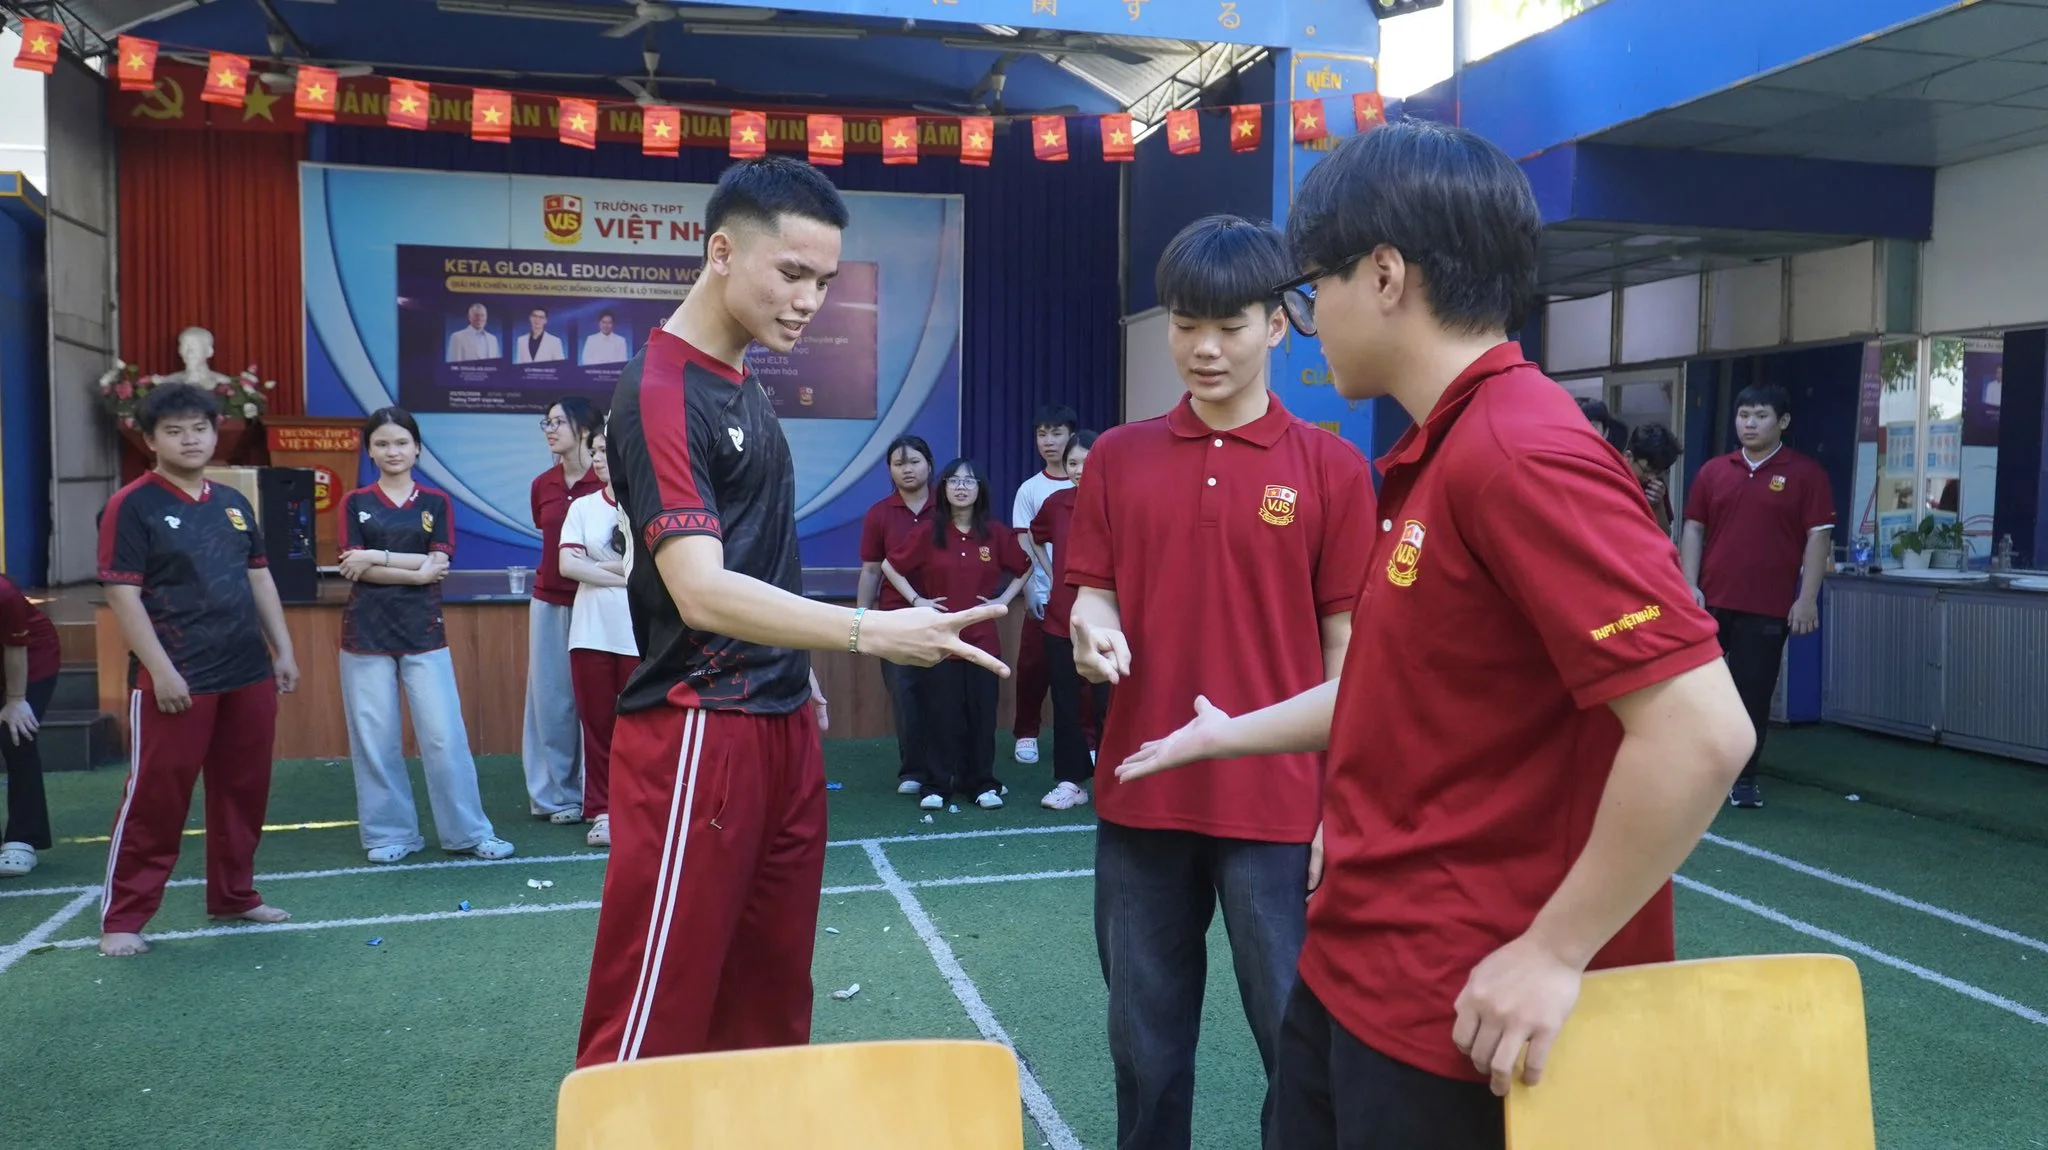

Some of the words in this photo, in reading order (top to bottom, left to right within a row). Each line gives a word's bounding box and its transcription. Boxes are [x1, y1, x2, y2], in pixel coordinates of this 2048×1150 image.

[512, 97, 540, 127] ẢN
[609, 110, 643, 133] NA
[680, 114, 731, 138] QUA
[766, 119, 806, 140] VIN
[917, 121, 959, 145] ĂM
[594, 200, 649, 213] TRƯỜNG
[652, 203, 684, 214] THPT
[548, 213, 579, 231] VJS
[594, 214, 663, 244] VIỆT
[671, 221, 704, 242] NH
[444, 258, 492, 274] KETA
[495, 261, 568, 277] GLOBAL
[571, 264, 671, 281] EDUCATION
[675, 268, 702, 281] WO
[767, 356, 789, 365] IELTS
[1267, 498, 1290, 514] VJS
[1396, 543, 1417, 566] VJS
